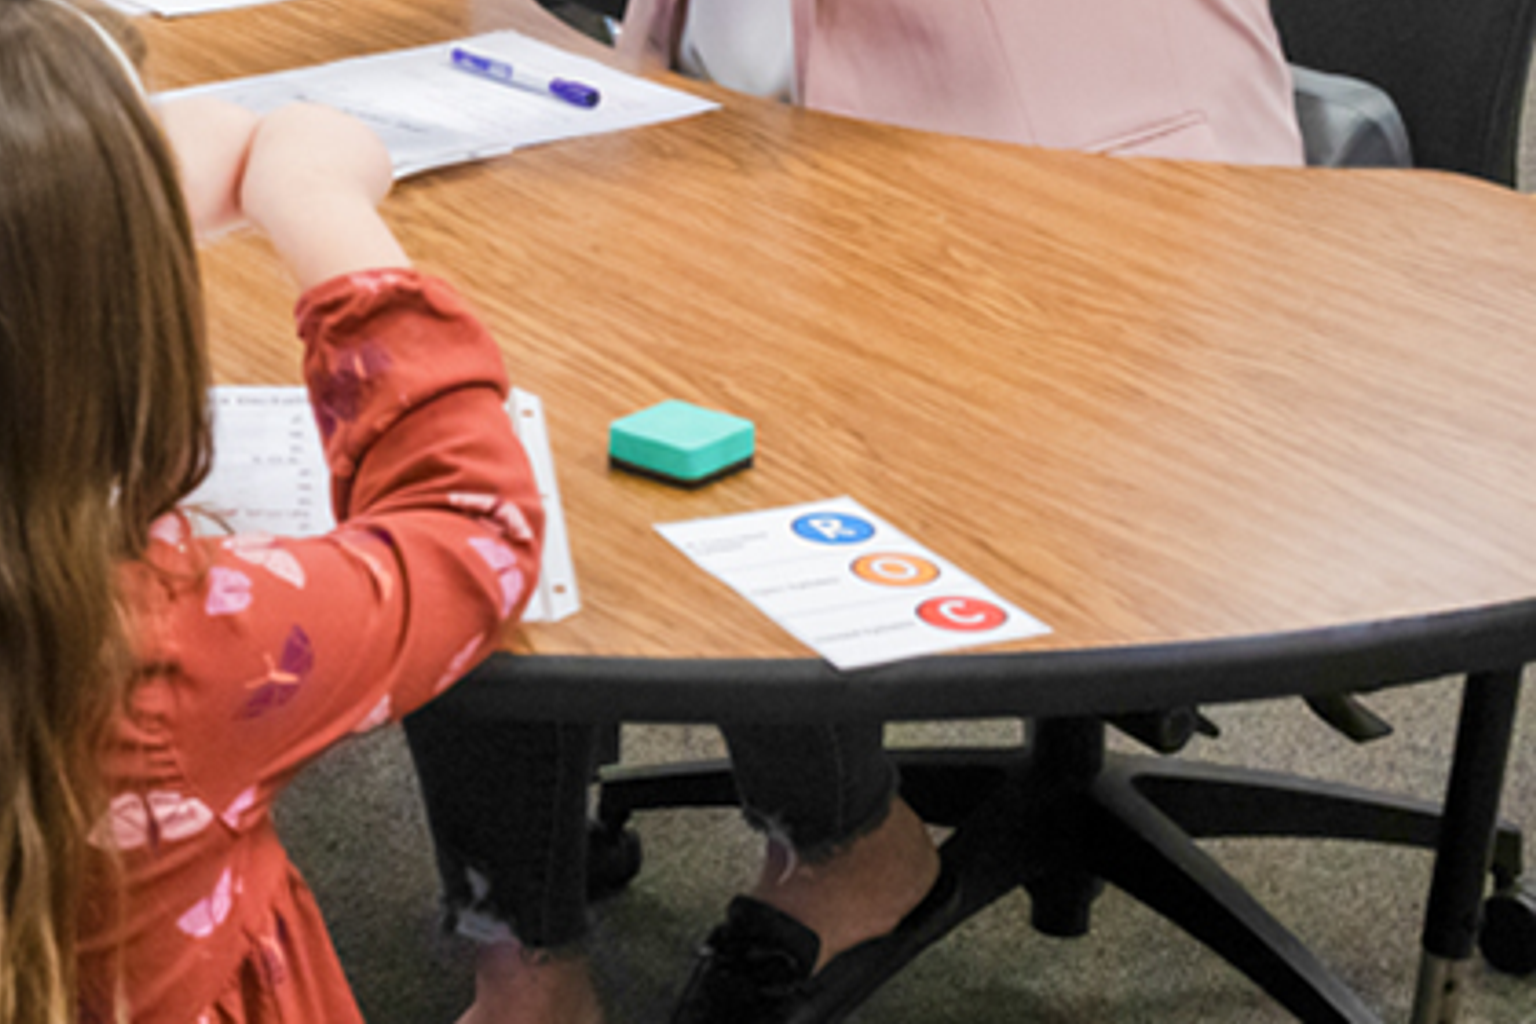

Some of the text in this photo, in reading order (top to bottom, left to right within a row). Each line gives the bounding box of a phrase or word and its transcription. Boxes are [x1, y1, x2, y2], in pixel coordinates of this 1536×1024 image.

[808, 516, 857, 540] R
[870, 555, 919, 581] O
[938, 598, 987, 624] C
